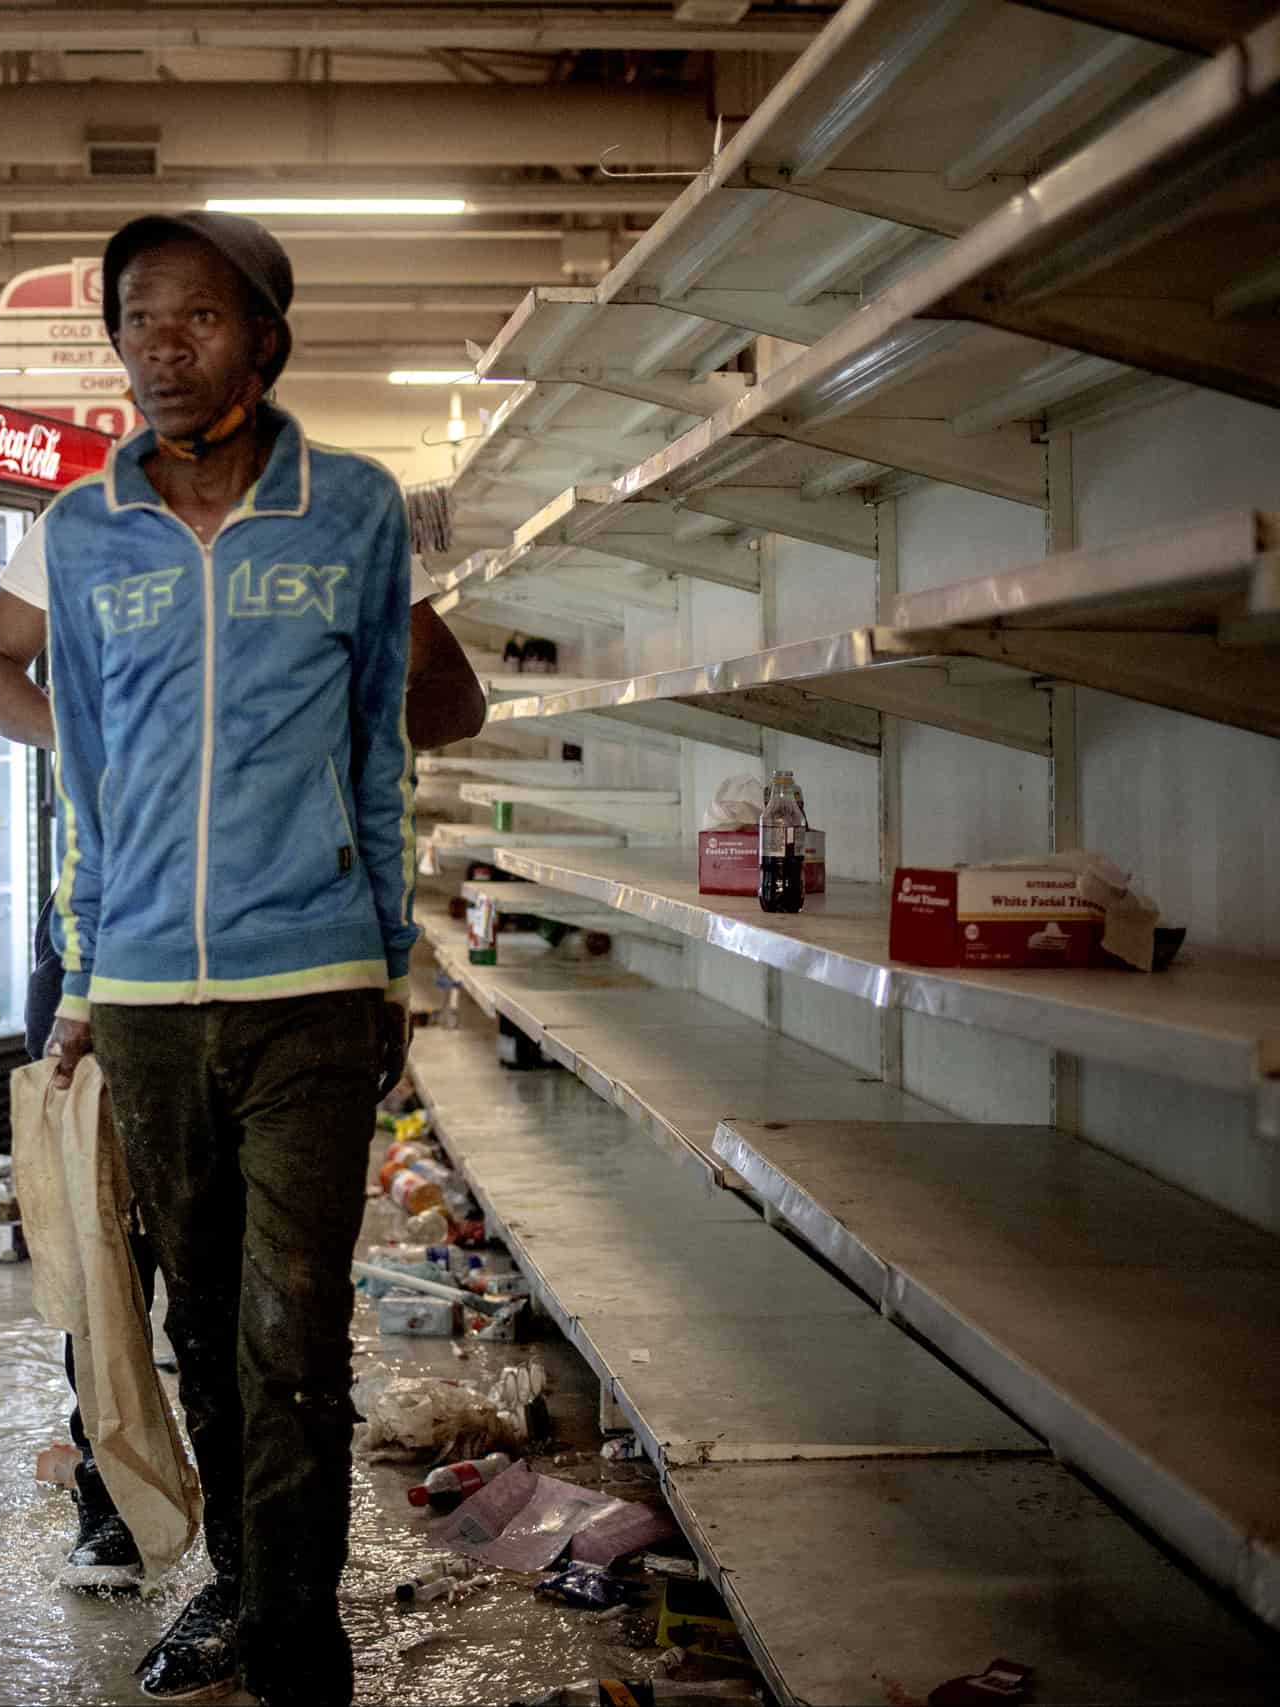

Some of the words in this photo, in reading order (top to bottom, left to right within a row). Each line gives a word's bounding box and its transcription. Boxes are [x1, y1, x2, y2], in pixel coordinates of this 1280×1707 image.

[49, 324, 93, 340] COLD
[52, 351, 94, 365] FRUIT
[80, 376, 126, 391] CHIPS
[991, 895, 1029, 908] White
[1030, 895, 1067, 908] Facial
